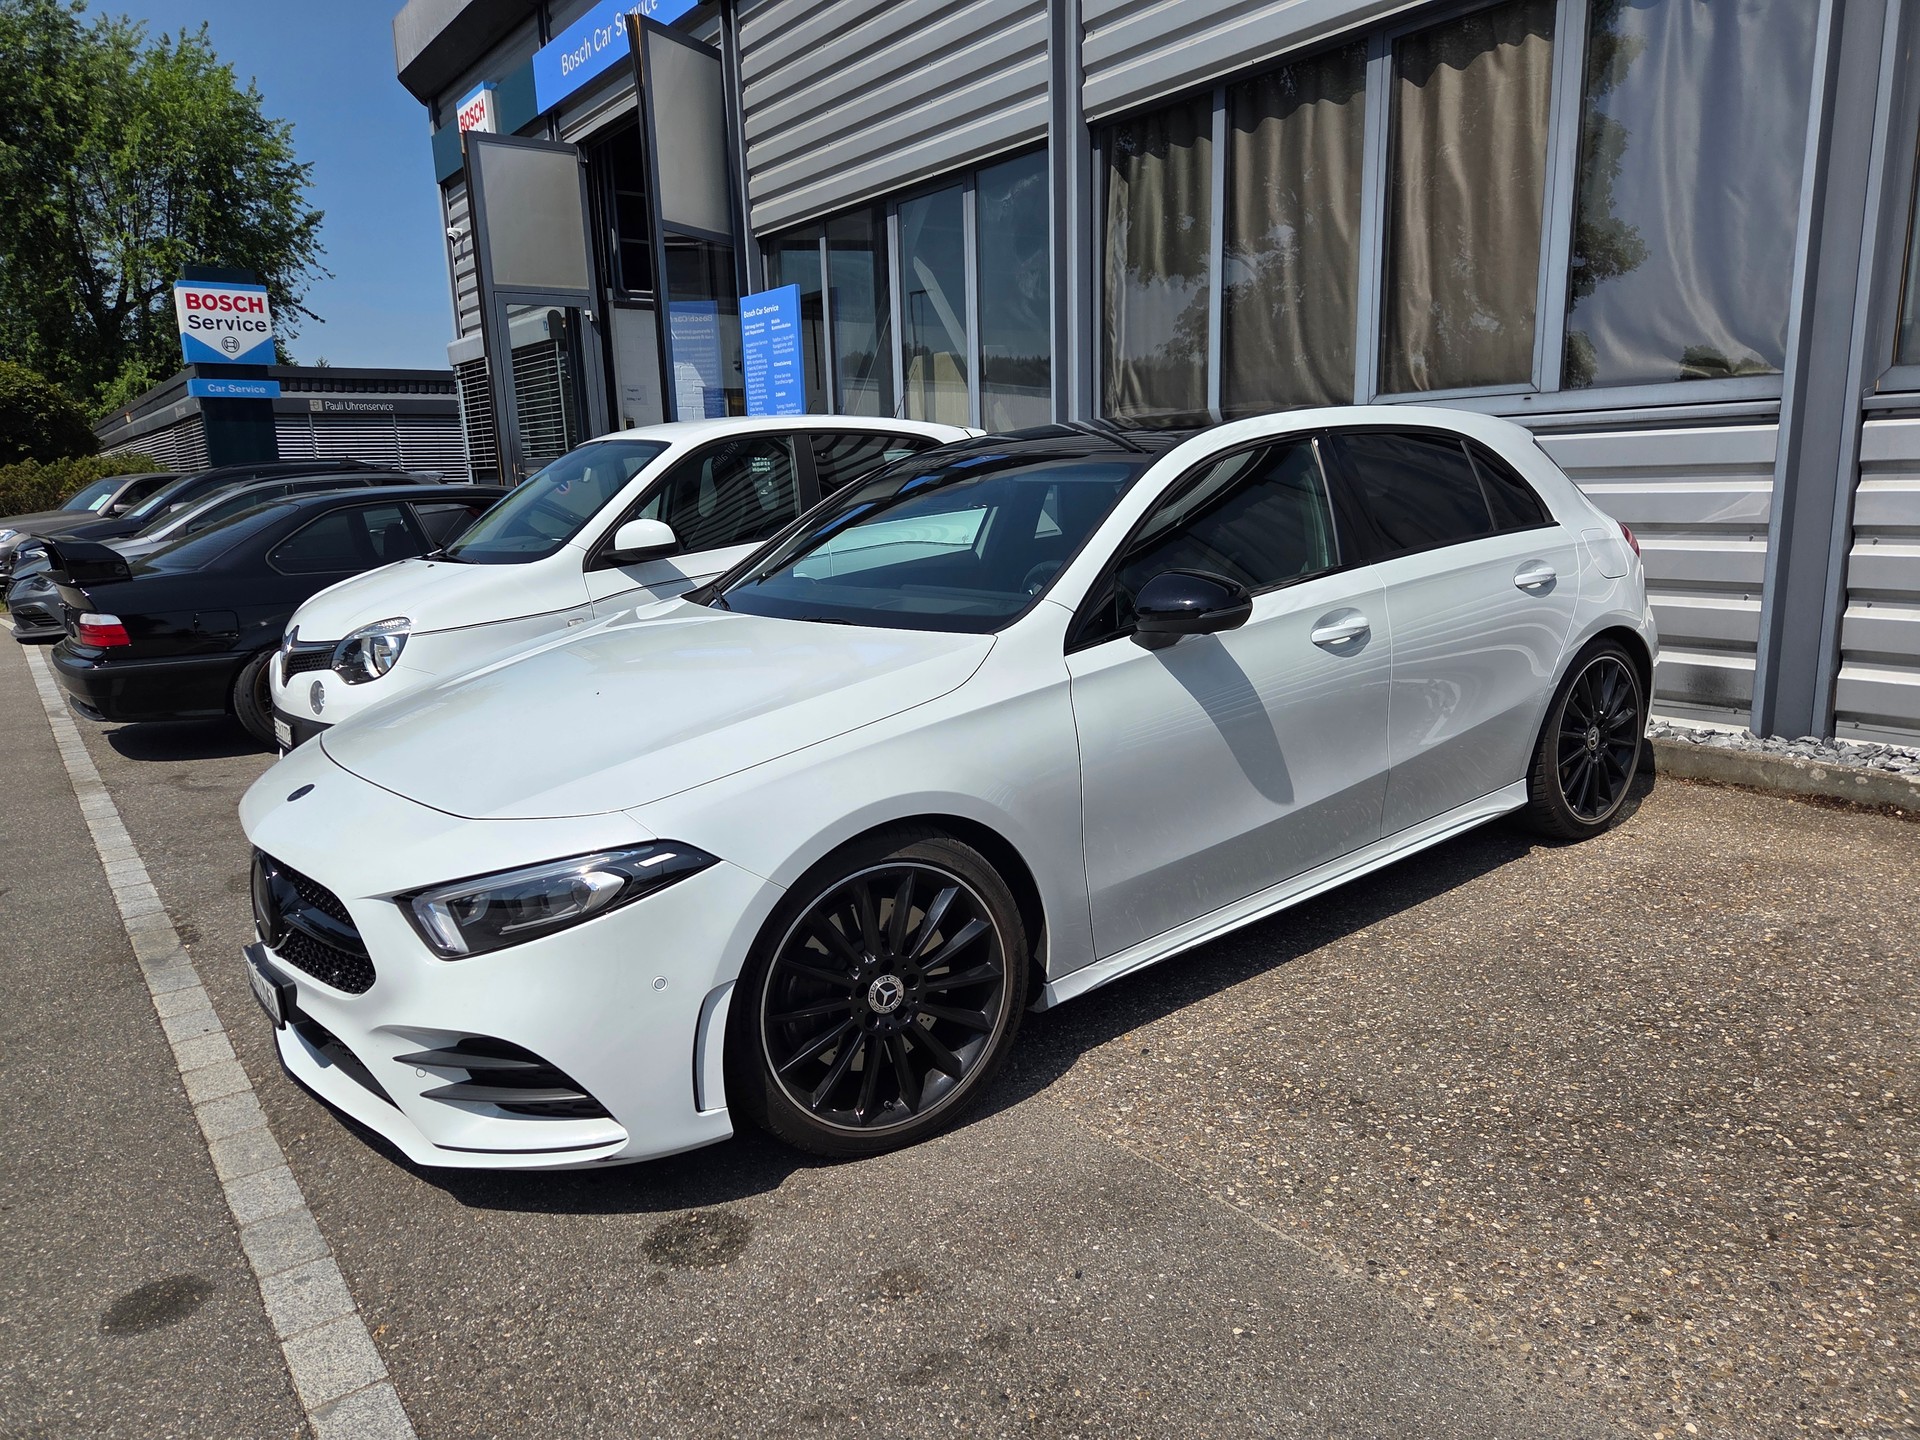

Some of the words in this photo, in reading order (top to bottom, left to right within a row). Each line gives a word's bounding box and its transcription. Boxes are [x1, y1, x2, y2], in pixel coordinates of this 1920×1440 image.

[561, 36, 592, 76] Bosch
[593, 25, 612, 52] Car
[460, 98, 486, 132] BOSCH
[185, 292, 265, 314] BOSCH
[743, 309, 756, 319] Bosch
[763, 304, 779, 314] Service
[187, 314, 268, 333] Service
[207, 383, 226, 393] Car
[228, 384, 267, 394] Service
[324, 401, 344, 411] Pauli
[344, 401, 394, 411] Uhrenservice
